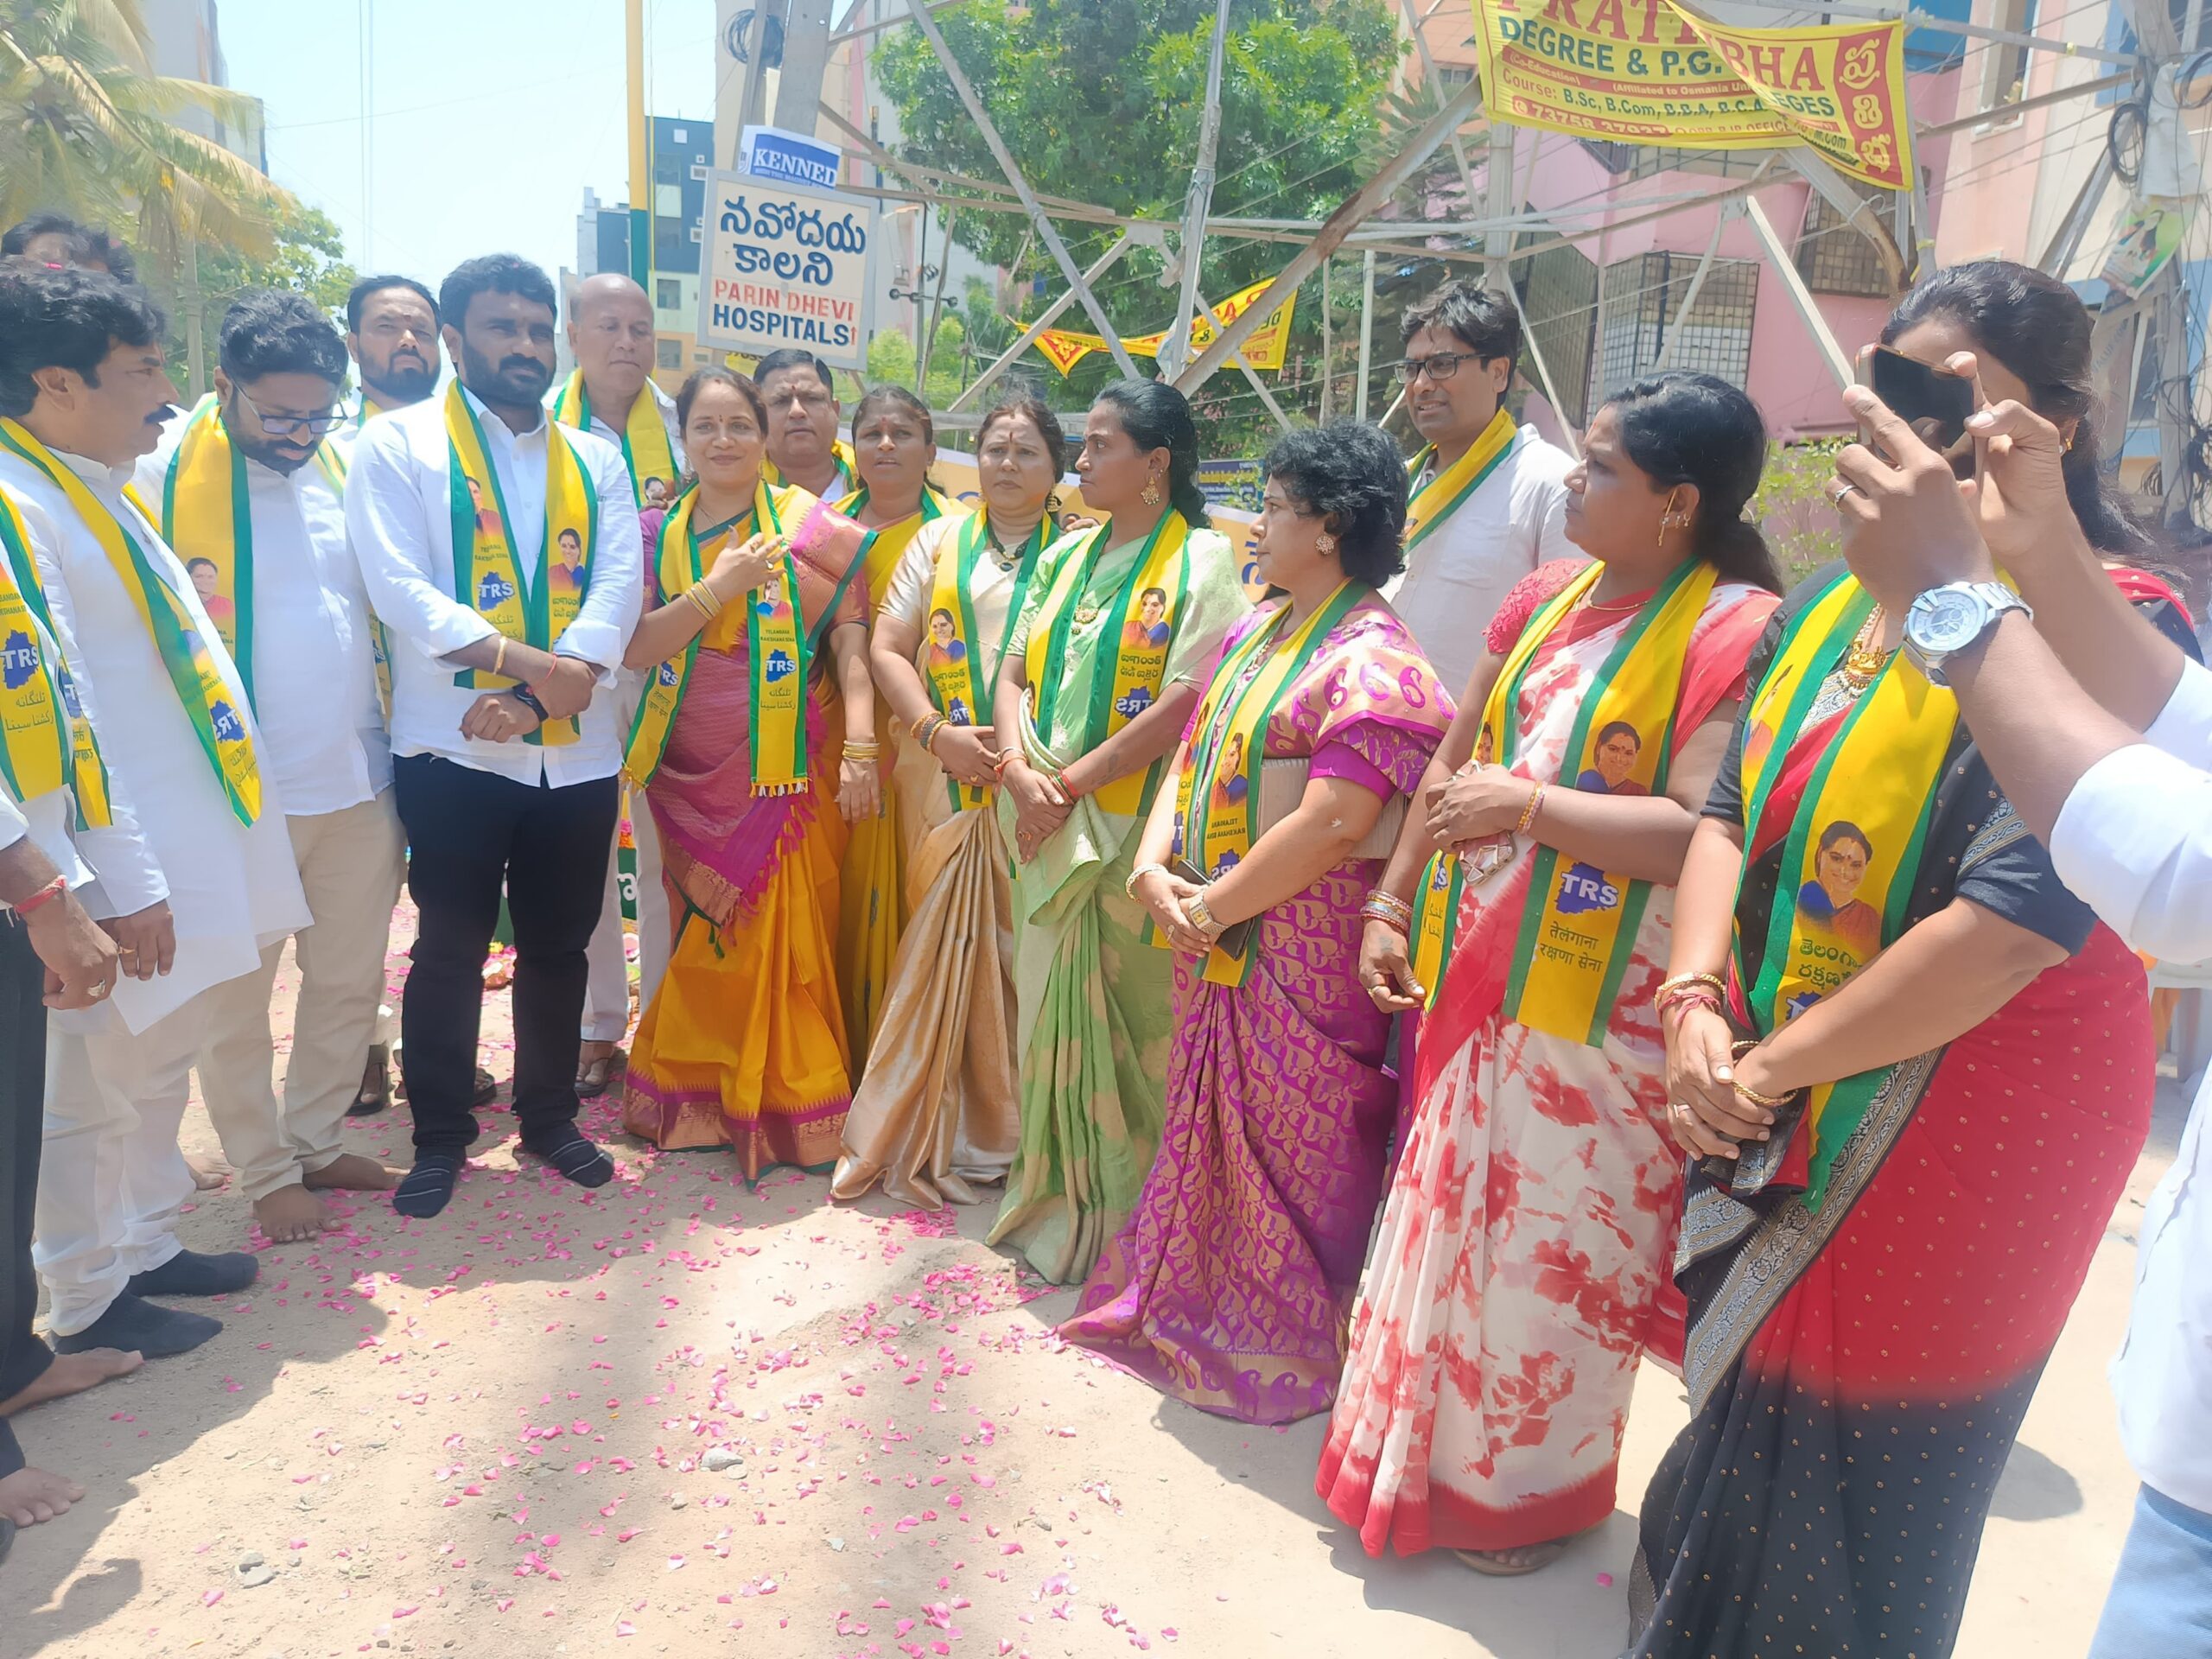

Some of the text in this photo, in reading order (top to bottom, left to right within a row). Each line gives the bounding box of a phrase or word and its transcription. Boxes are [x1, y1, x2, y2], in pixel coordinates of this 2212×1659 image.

[1498, 16, 1615, 73] DEGREE
[1626, 48, 1649, 76] &
[1661, 50, 1722, 77] P.G.
[1503, 68, 1557, 99] Course:
[1605, 96, 1662, 119] B.Com,
[1667, 85, 1678, 96] to
[1680, 83, 1729, 96] Osmania
[753, 148, 838, 188] KENNED
[721, 195, 866, 254] నవోదయ
[733, 243, 834, 286] కాలని
[715, 278, 854, 321] PARIN DHEVI
[713, 303, 849, 346] HOSPITALS
[478, 582, 514, 599] TRS
[0, 645, 38, 670] TRS
[766, 659, 797, 672] TRS
[660, 669, 679, 685] RS
[1560, 872, 1618, 906] TRS
[1549, 921, 1599, 950] तेलंगाना
[1578, 951, 1604, 973] सेना
[1800, 938, 1863, 969] తెలంగా
